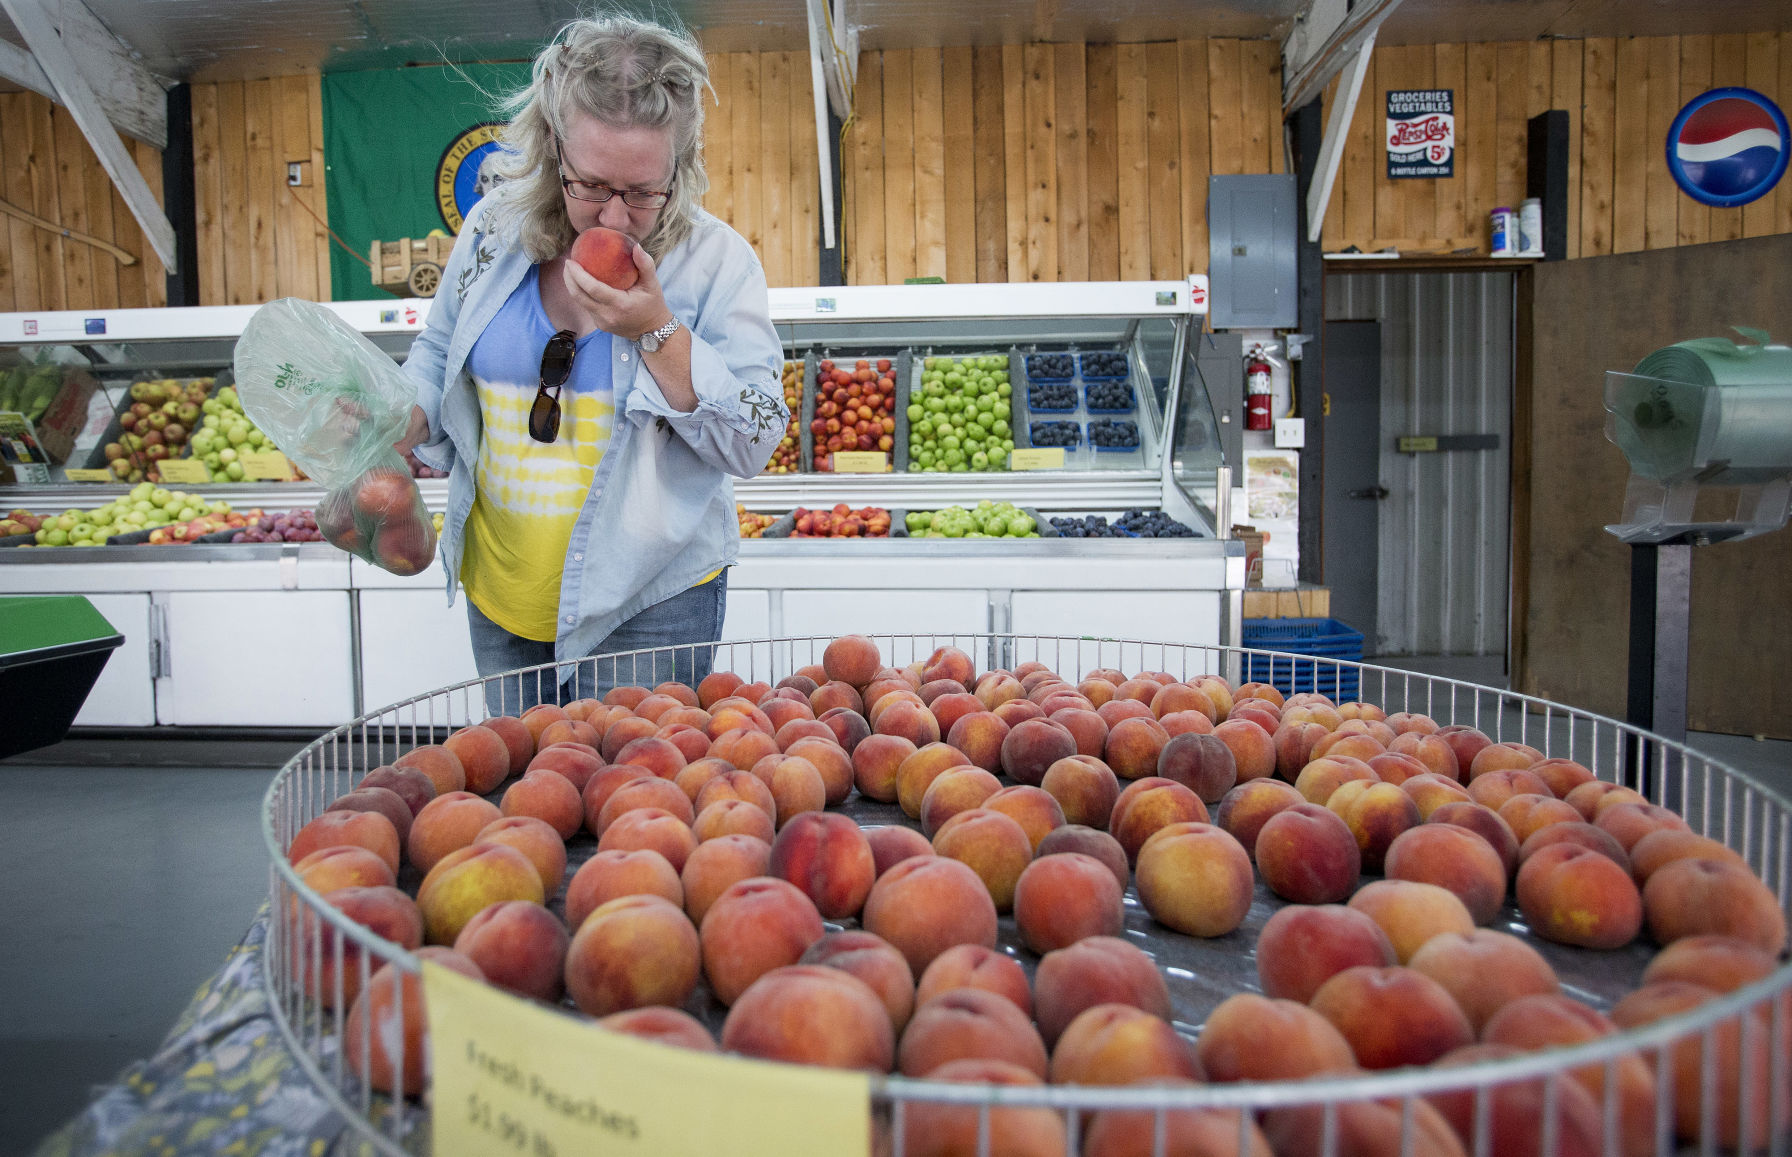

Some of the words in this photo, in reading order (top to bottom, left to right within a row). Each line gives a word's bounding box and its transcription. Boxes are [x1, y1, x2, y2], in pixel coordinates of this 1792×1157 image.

[1391, 91, 1449, 102] GROCERIES
[1389, 102, 1451, 113] VEGETABLES
[451, 136, 477, 161] THE
[442, 167, 454, 184] OF
[442, 190, 461, 228] SEAL
[465, 1039, 526, 1092] Fresh
[528, 1073, 640, 1140] Peaches
